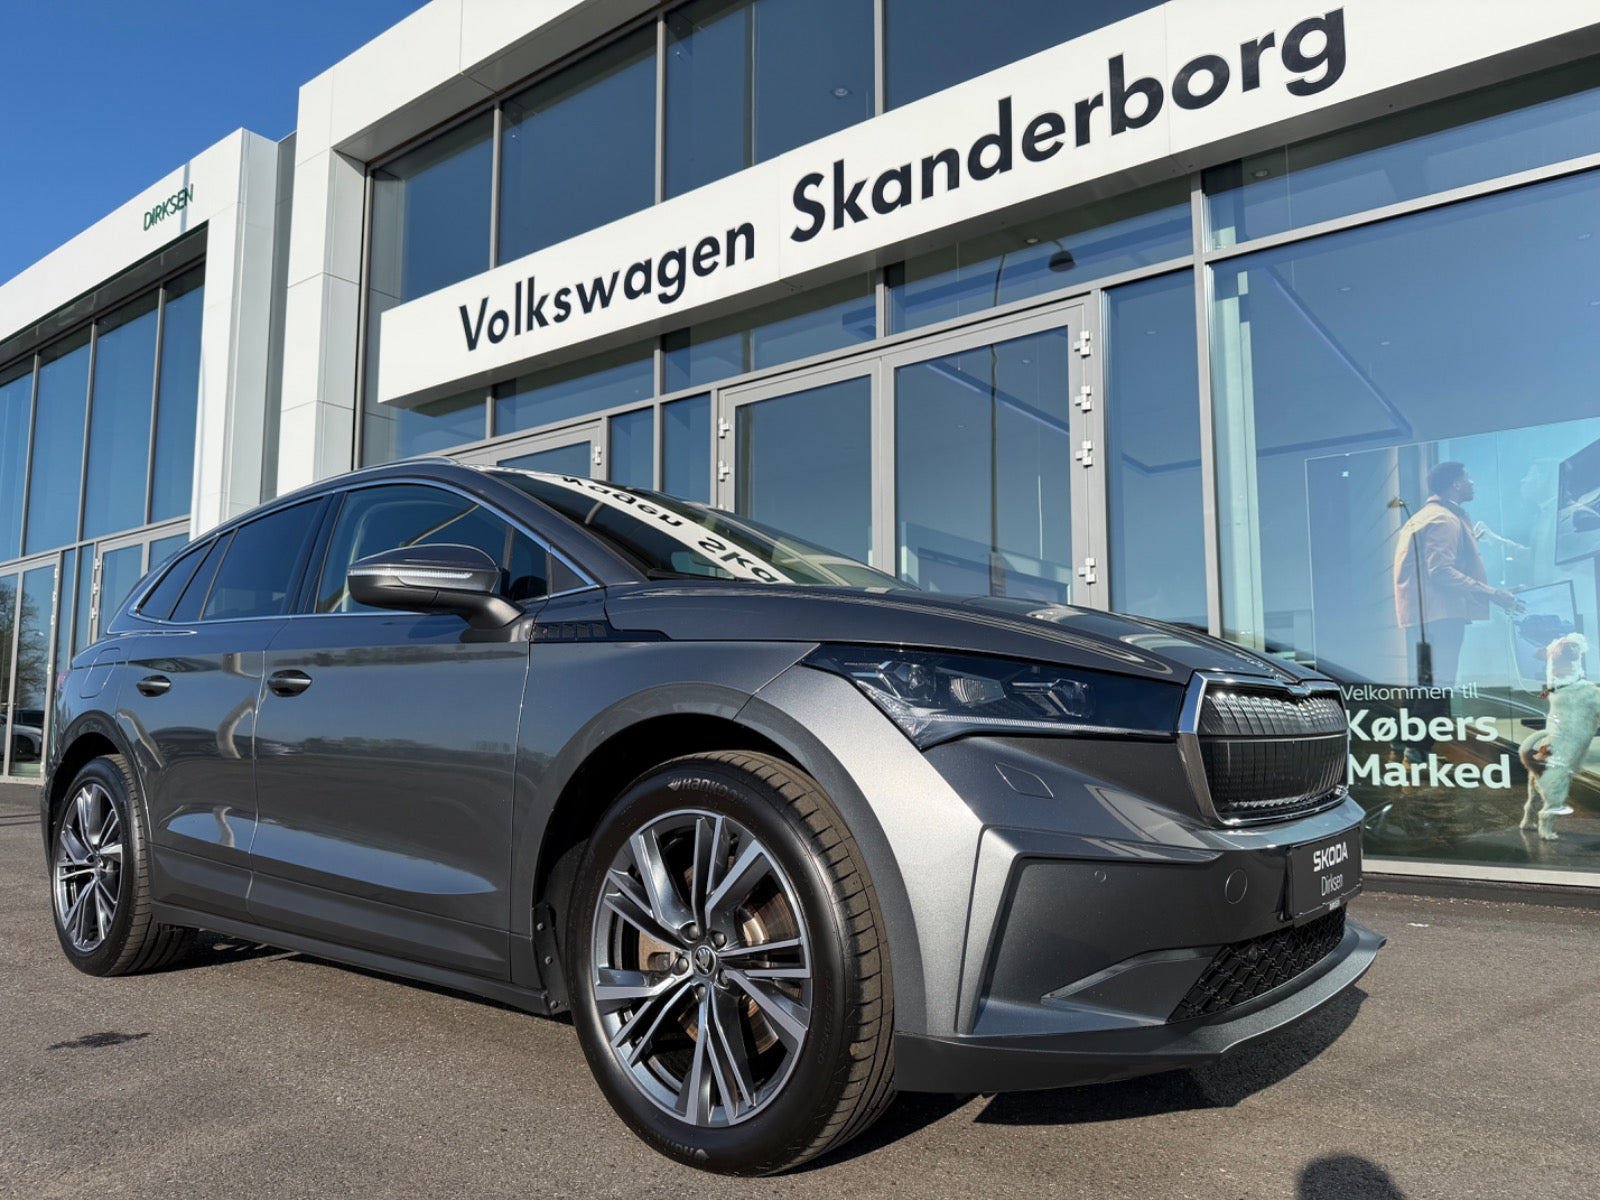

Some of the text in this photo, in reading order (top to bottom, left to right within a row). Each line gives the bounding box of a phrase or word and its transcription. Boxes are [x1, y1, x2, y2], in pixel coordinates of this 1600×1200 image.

[459, 7, 1347, 351] Volkswagen Skanderborg
[143, 183, 194, 231] DIRKSEN
[1340, 682, 1479, 700] Velkommen til
[1346, 708, 1499, 742] Købers
[1349, 753, 1512, 789] Marked
